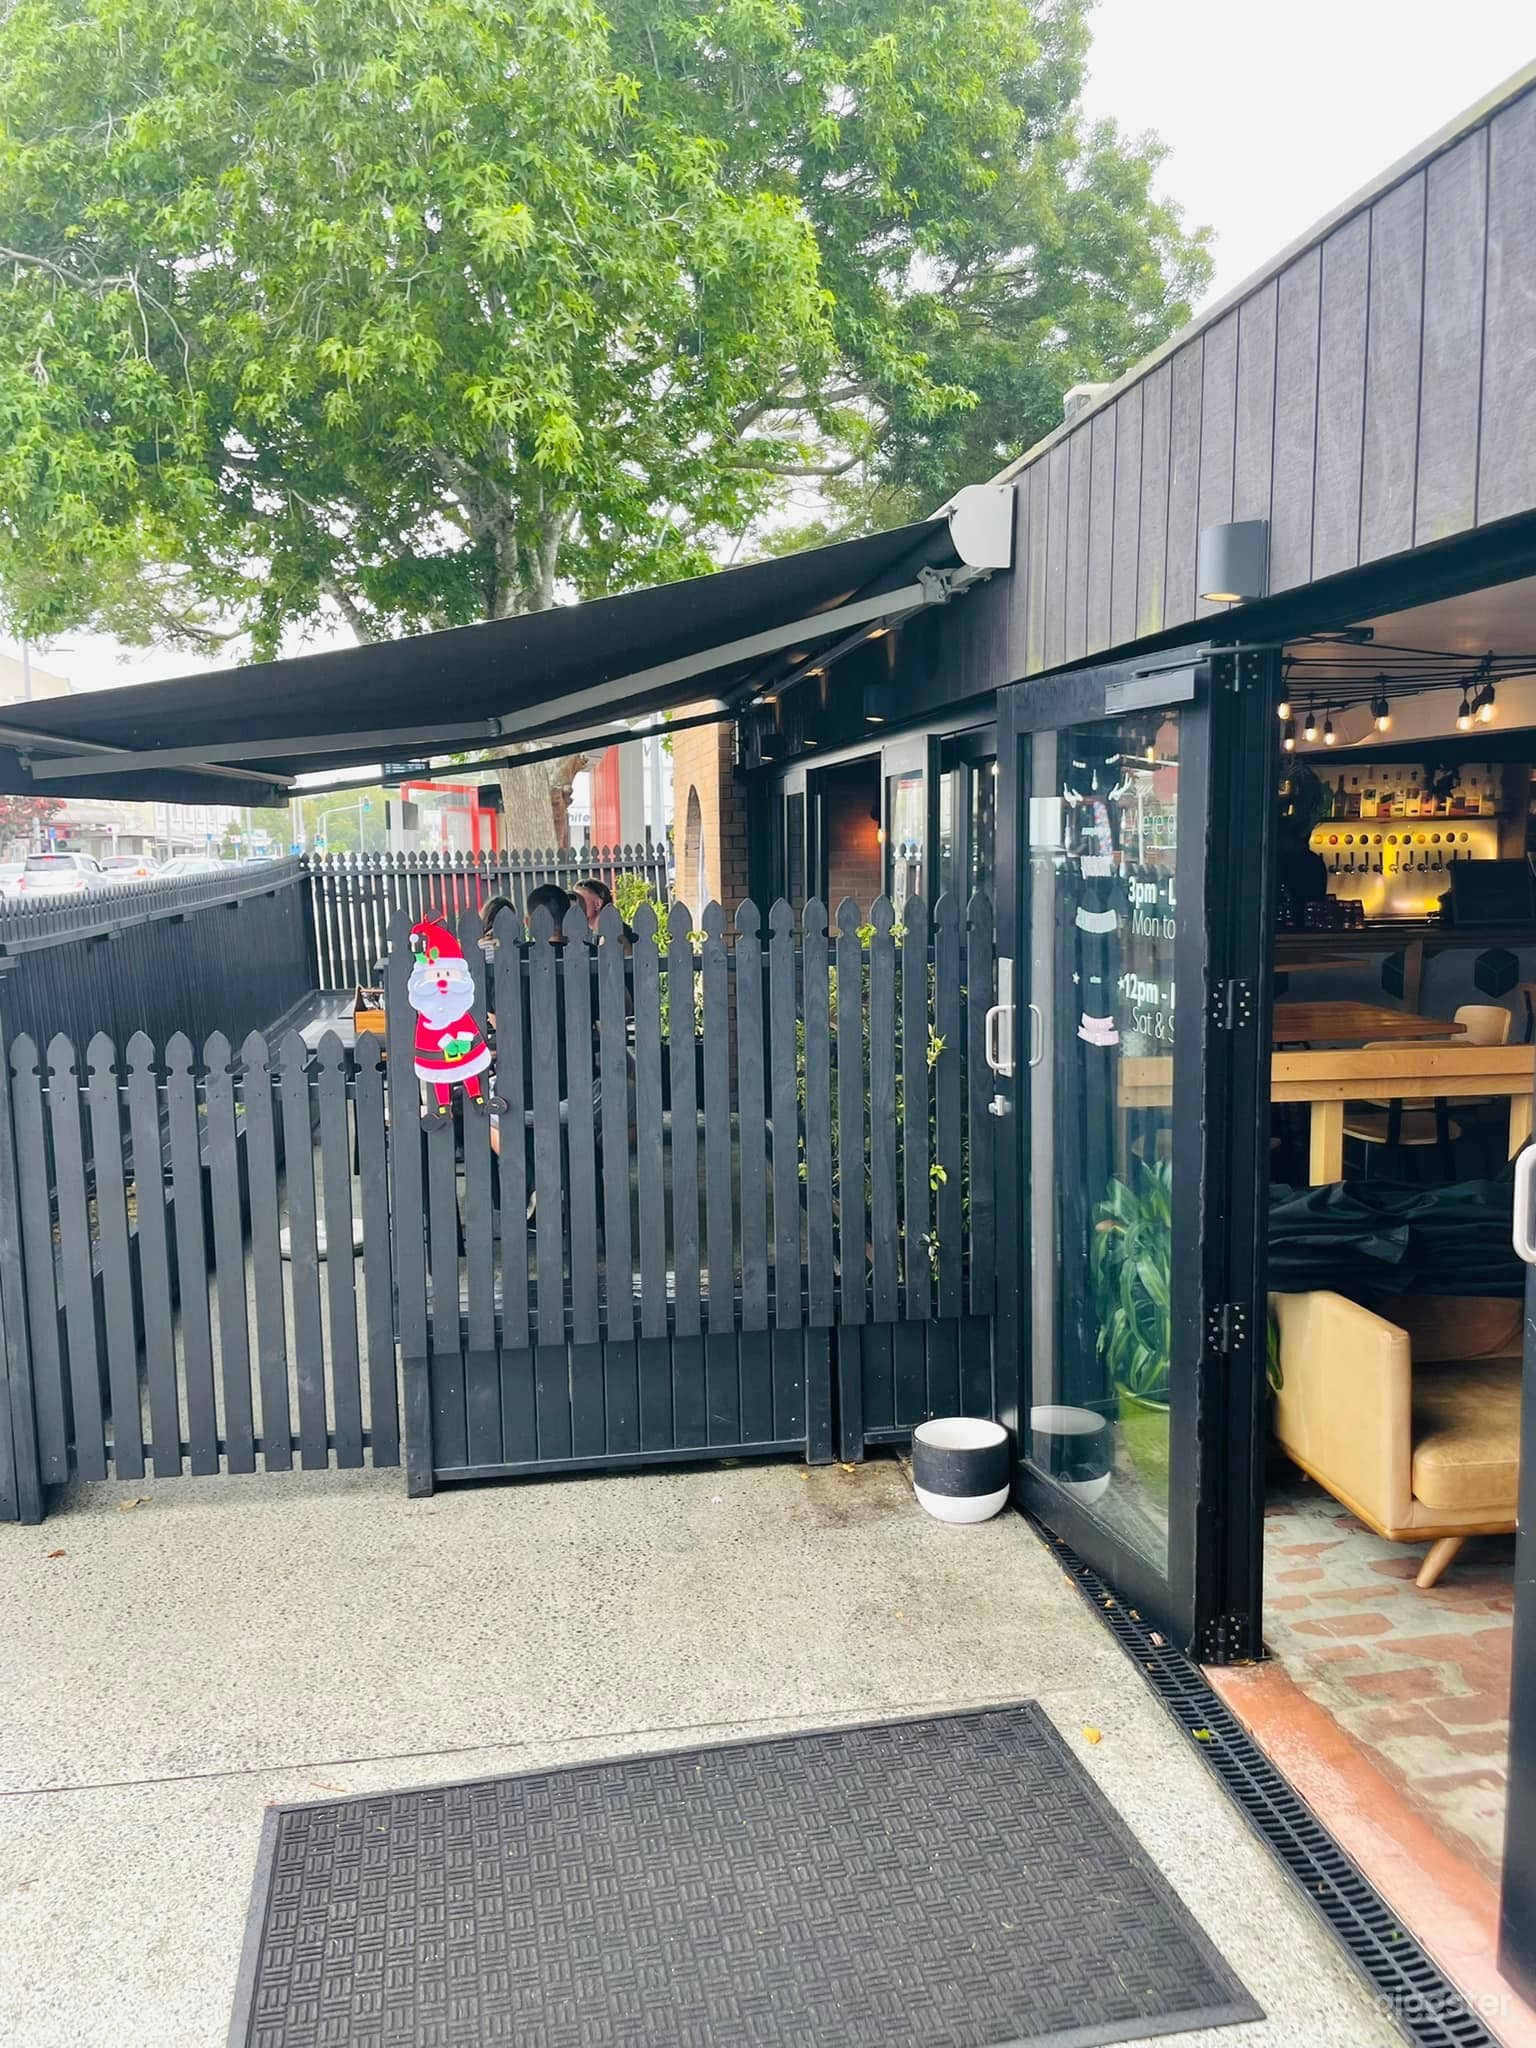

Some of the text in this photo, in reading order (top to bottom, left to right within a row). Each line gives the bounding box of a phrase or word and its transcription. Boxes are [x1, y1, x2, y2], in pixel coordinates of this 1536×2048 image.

[1128, 876, 1157, 909] 3pm
[1132, 909, 1176, 940] Mon to
[1132, 1006, 1153, 1037] Sat
[1154, 1011, 1166, 1040] &
